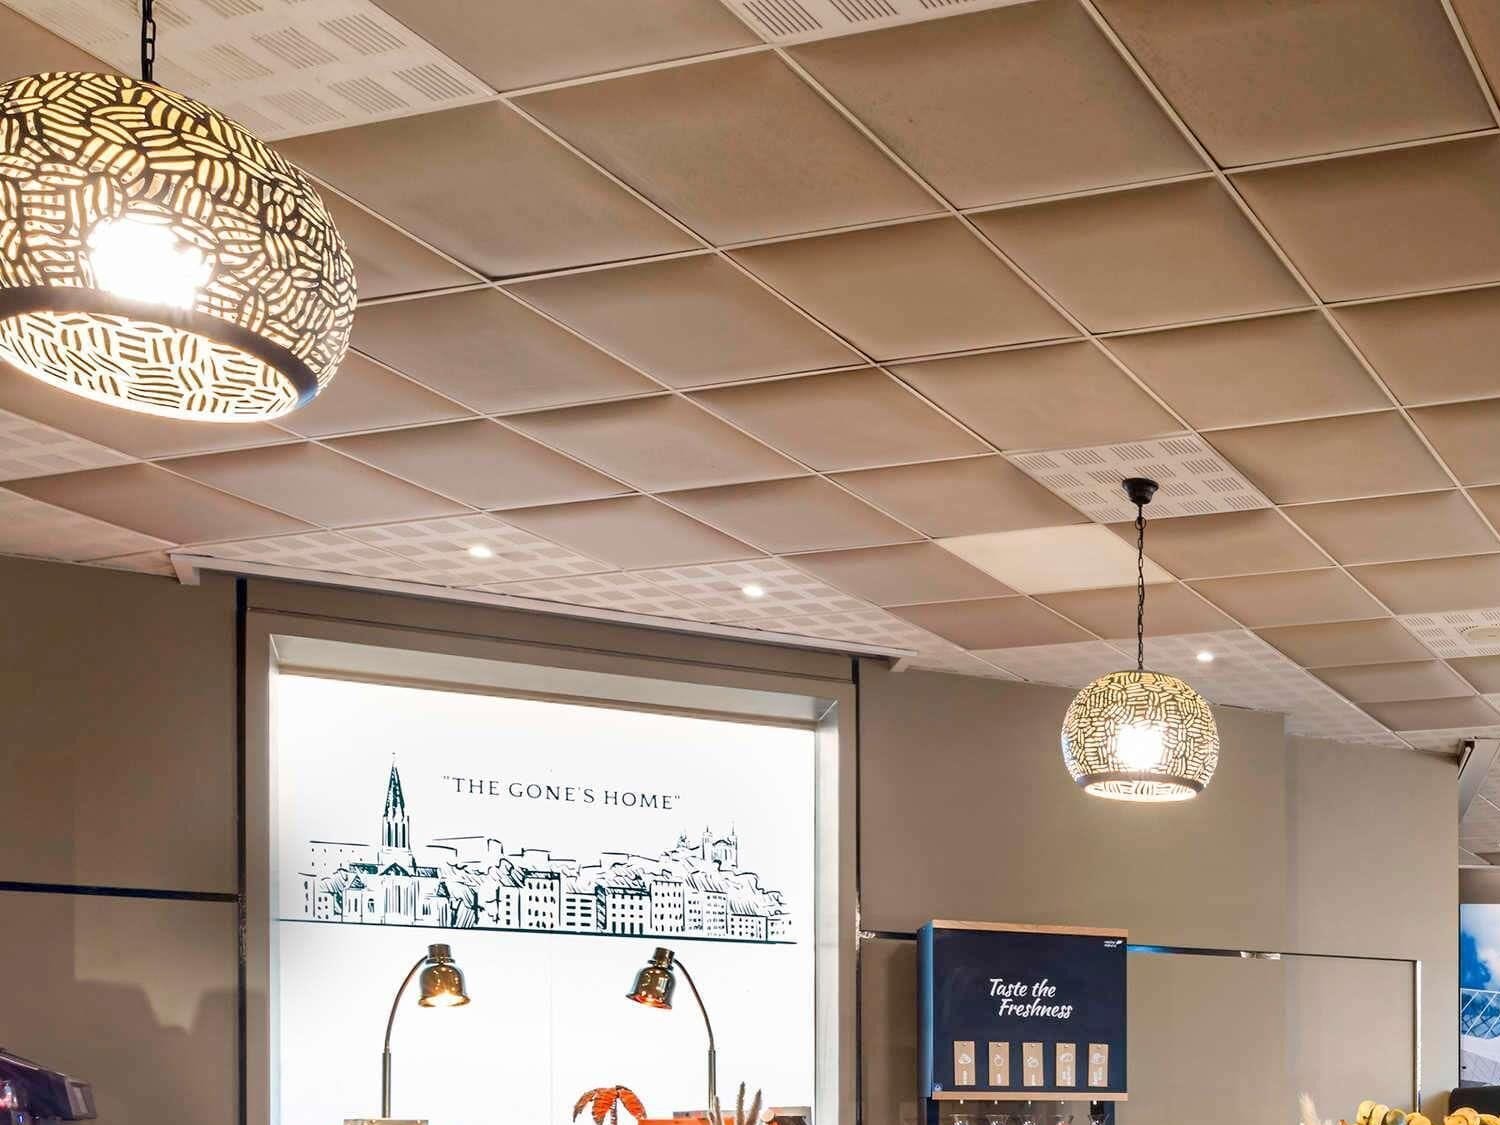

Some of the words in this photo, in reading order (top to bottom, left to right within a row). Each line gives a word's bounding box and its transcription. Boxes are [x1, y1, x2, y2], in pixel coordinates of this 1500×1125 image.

[508, 782, 596, 804] GONE'S
[989, 978, 1028, 997] Taste
[1031, 978, 1057, 998] the
[998, 998, 1073, 1019] Freshness
